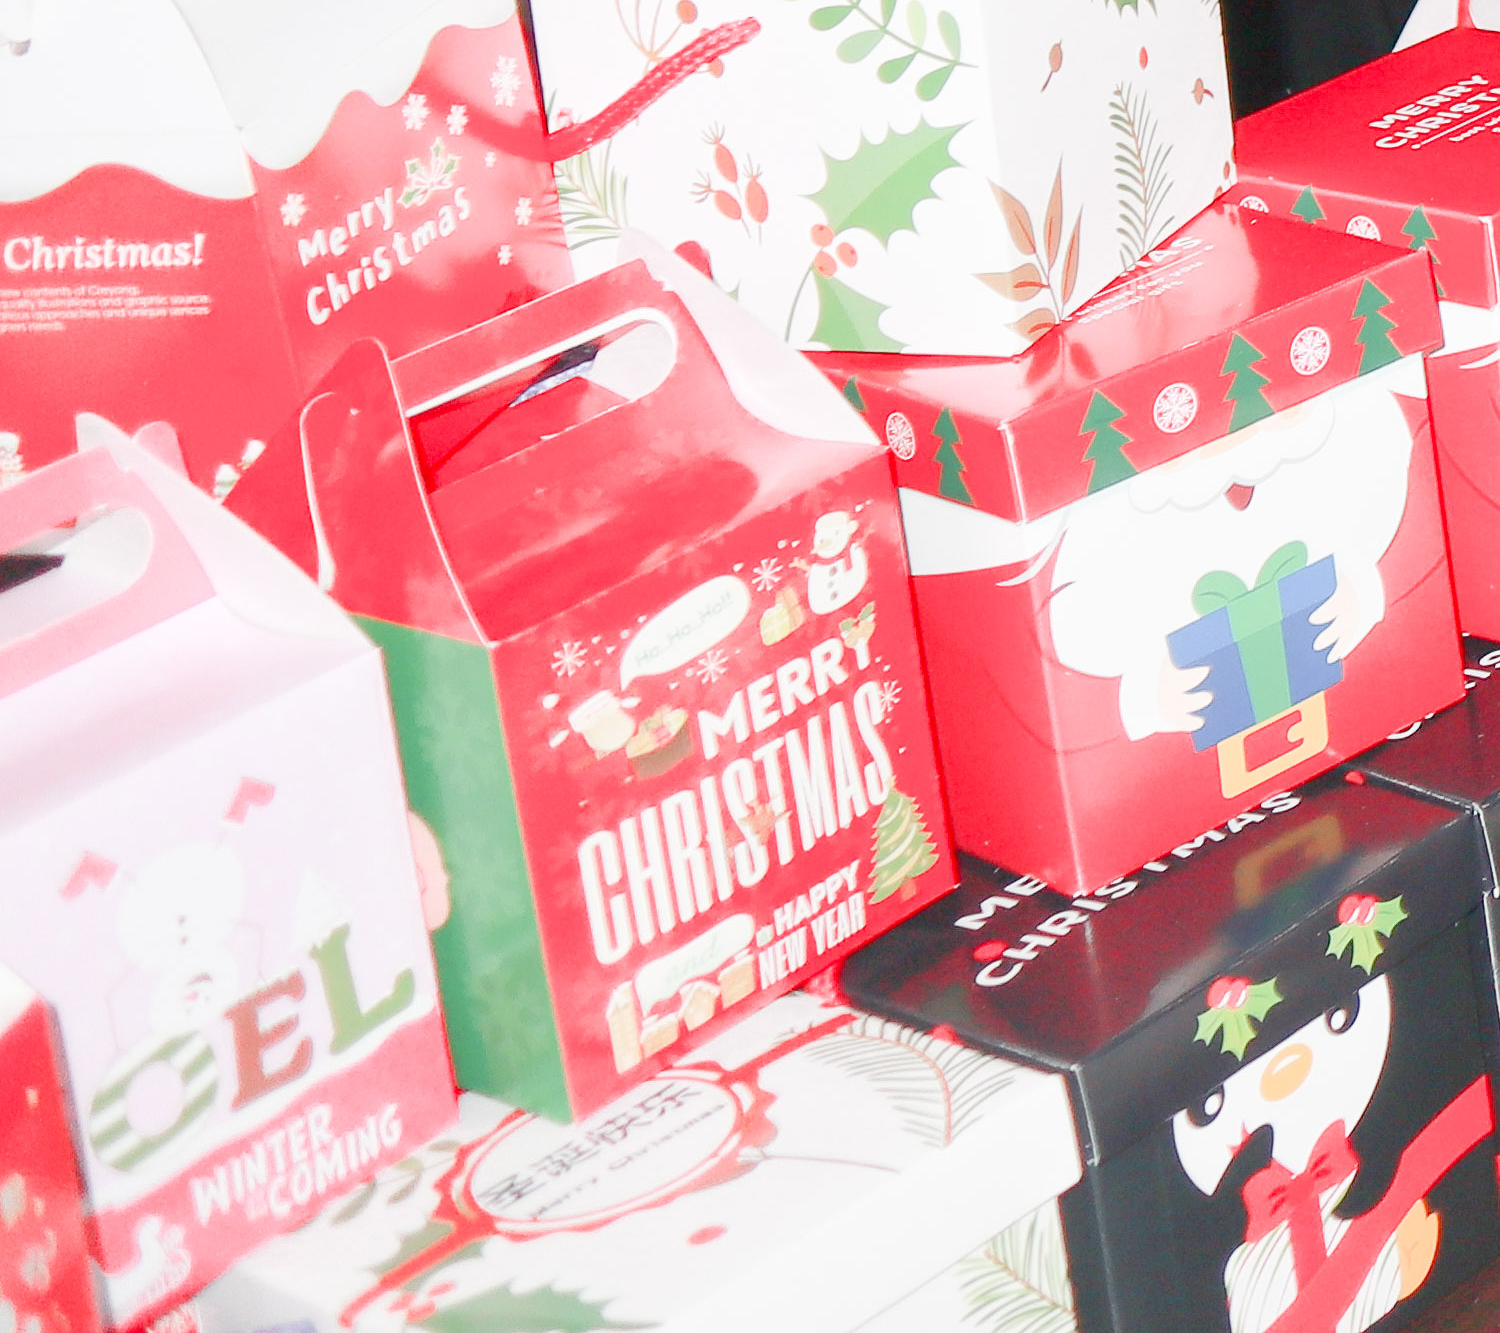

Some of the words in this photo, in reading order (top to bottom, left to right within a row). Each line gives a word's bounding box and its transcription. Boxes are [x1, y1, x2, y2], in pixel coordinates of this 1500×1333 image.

[1369, 75, 1489, 130] MERRY
[3, 232, 207, 271] Christmas!
[298, 187, 393, 267] Merry
[306, 186, 471, 326] Christmas
[698, 634, 873, 761] MERRY
[578, 680, 895, 966] CHRISTMAS
[758, 923, 808, 990] NEW
[808, 891, 867, 958] YEAR
[774, 859, 861, 937] HAPPY
[89, 923, 415, 1173] OEL
[191, 1103, 333, 1227] WINTER
[269, 1102, 403, 1217] COMING
[475, 1081, 702, 1210] 圣诞快乐
